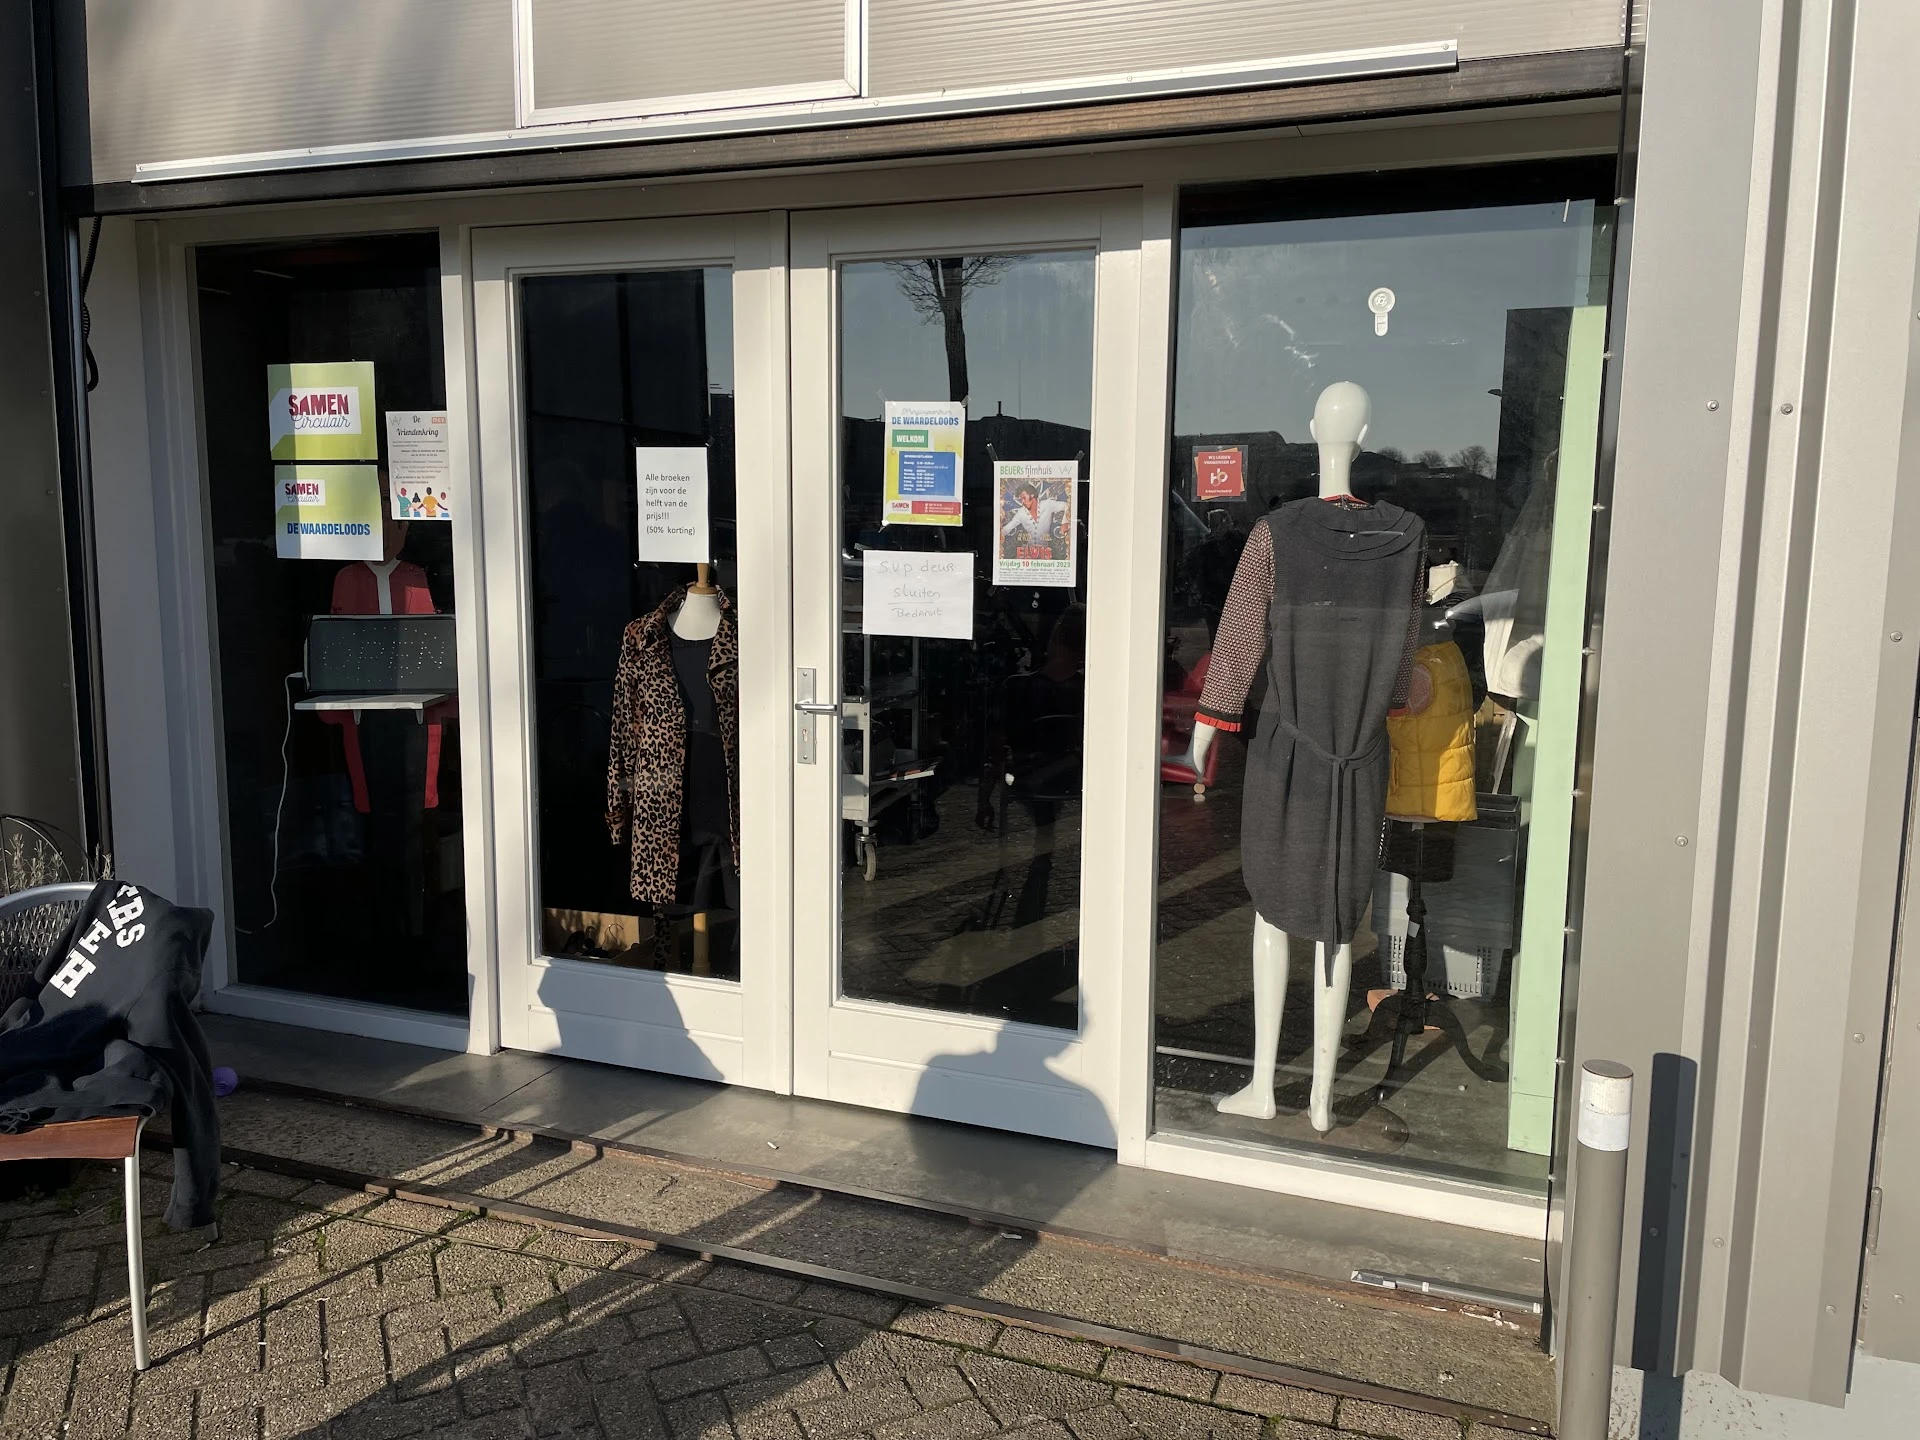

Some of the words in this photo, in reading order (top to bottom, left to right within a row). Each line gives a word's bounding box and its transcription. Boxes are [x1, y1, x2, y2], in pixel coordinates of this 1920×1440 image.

[288, 394, 350, 416] SAMEN
[291, 413, 351, 430] Circulair
[892, 416, 901, 425] DE
[903, 416, 959, 426] WAARDELOODS
[396, 428, 439, 437] Vriendenkring
[896, 434, 925, 443] WELKOM
[1025, 465, 1052, 477] filmhuis
[645, 474, 659, 482] Alle
[660, 474, 690, 482] broeken
[285, 483, 319, 495] SAMEN
[645, 487, 658, 496] zijn
[677, 487, 687, 495] de
[645, 499, 663, 507] helft
[678, 499, 688, 508] de
[646, 512, 670, 521] prijs!!!
[287, 522, 299, 535] DE
[300, 522, 371, 536] WAARDELOODS
[646, 526, 664, 535] (50%
[667, 526, 696, 536] korting)
[1016, 546, 1053, 559] ELVIS
[999, 560, 1020, 568] Vrijdag
[1030, 560, 1055, 568] februari
[323, 641, 445, 670] OPEN
